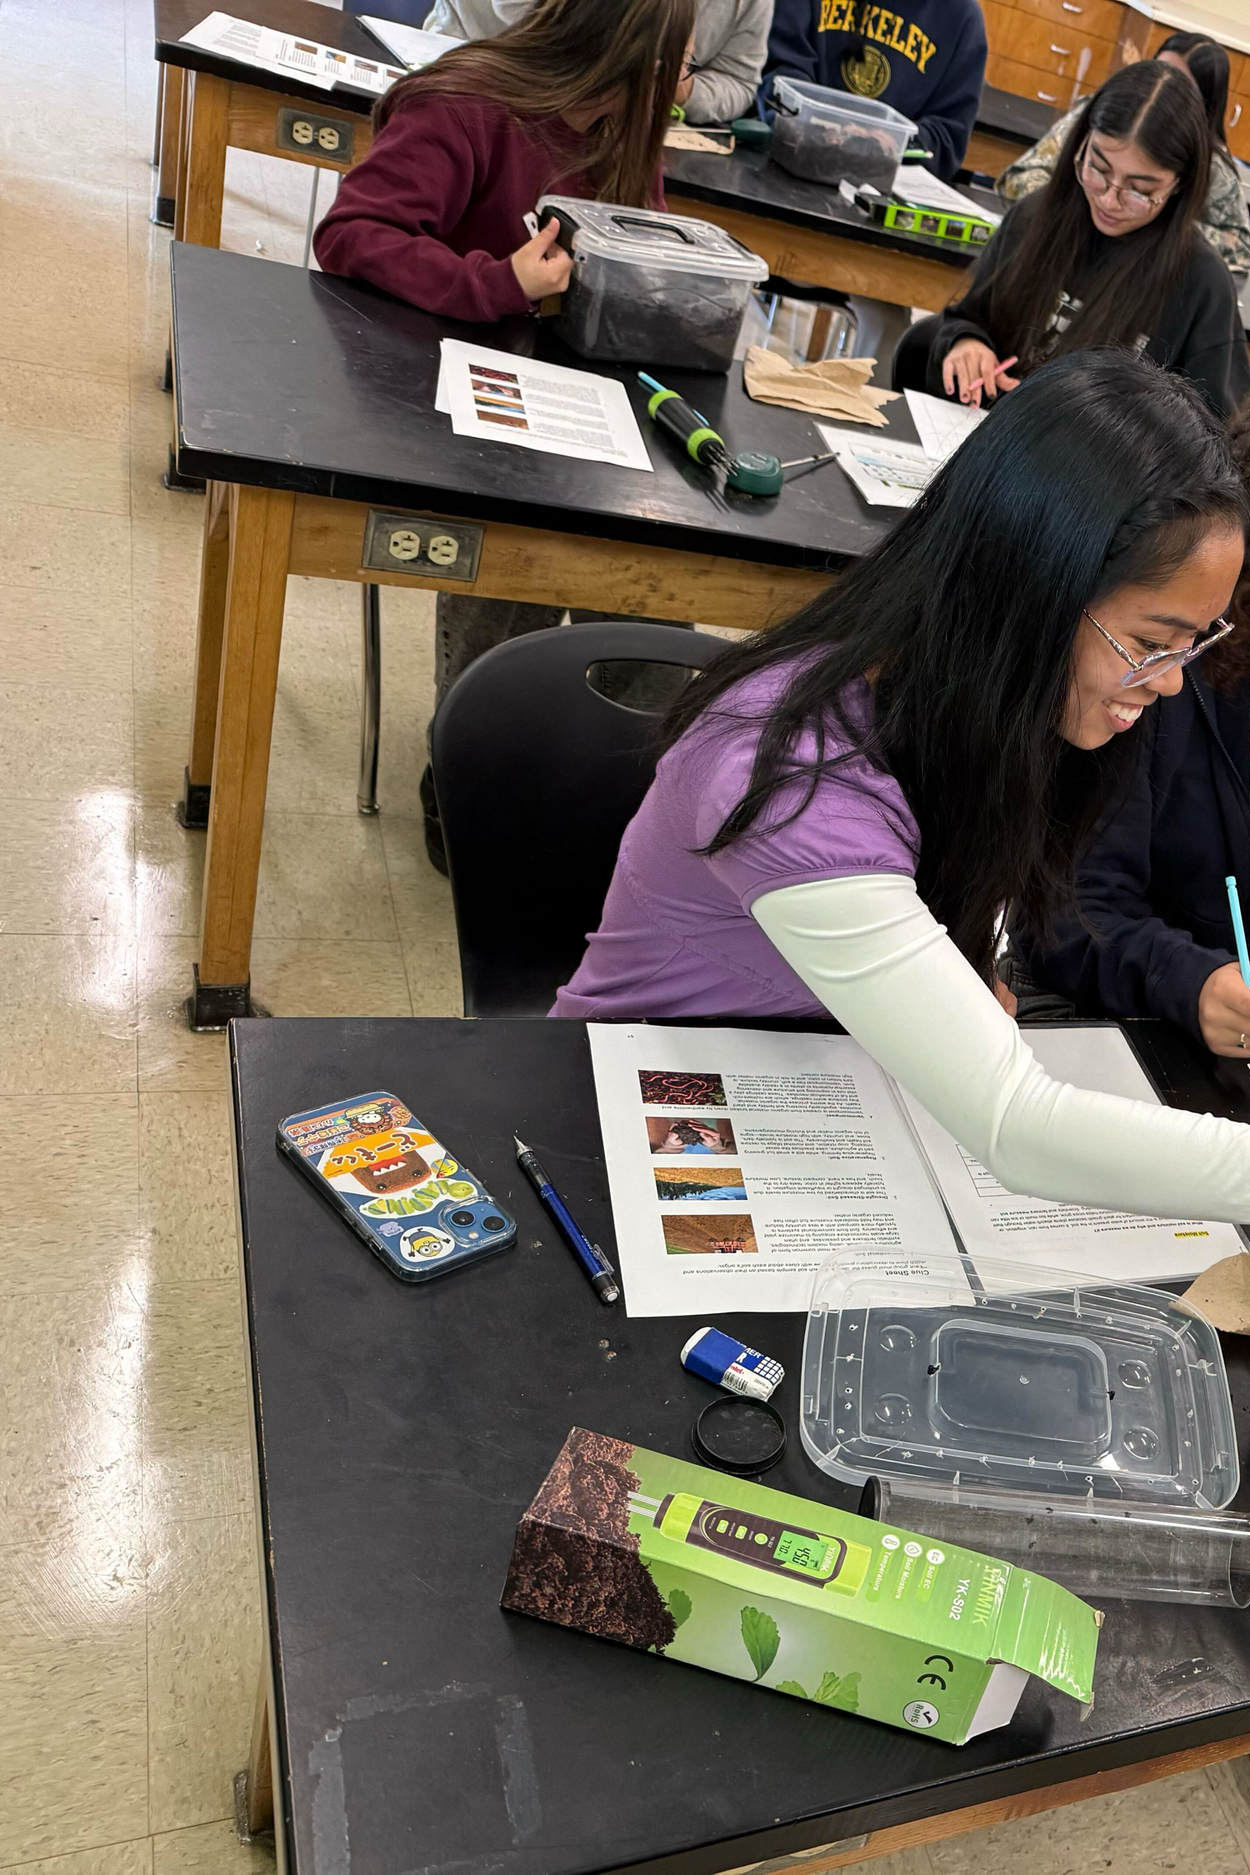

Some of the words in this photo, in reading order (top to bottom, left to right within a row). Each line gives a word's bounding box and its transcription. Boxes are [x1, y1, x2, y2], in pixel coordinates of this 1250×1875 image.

[330, 1131, 418, 1166] どーもくん
[905, 1556, 914, 1571] Soil
[931, 1551, 940, 1562] EC
[872, 1551, 892, 1592] Temperature
[927, 1565, 935, 1579] Soil
[895, 1570, 910, 1600] Moisture
[922, 1579, 932, 1590] EC
[949, 1578, 970, 1621] YK-S02
[911, 1701, 925, 1726] RoHS
